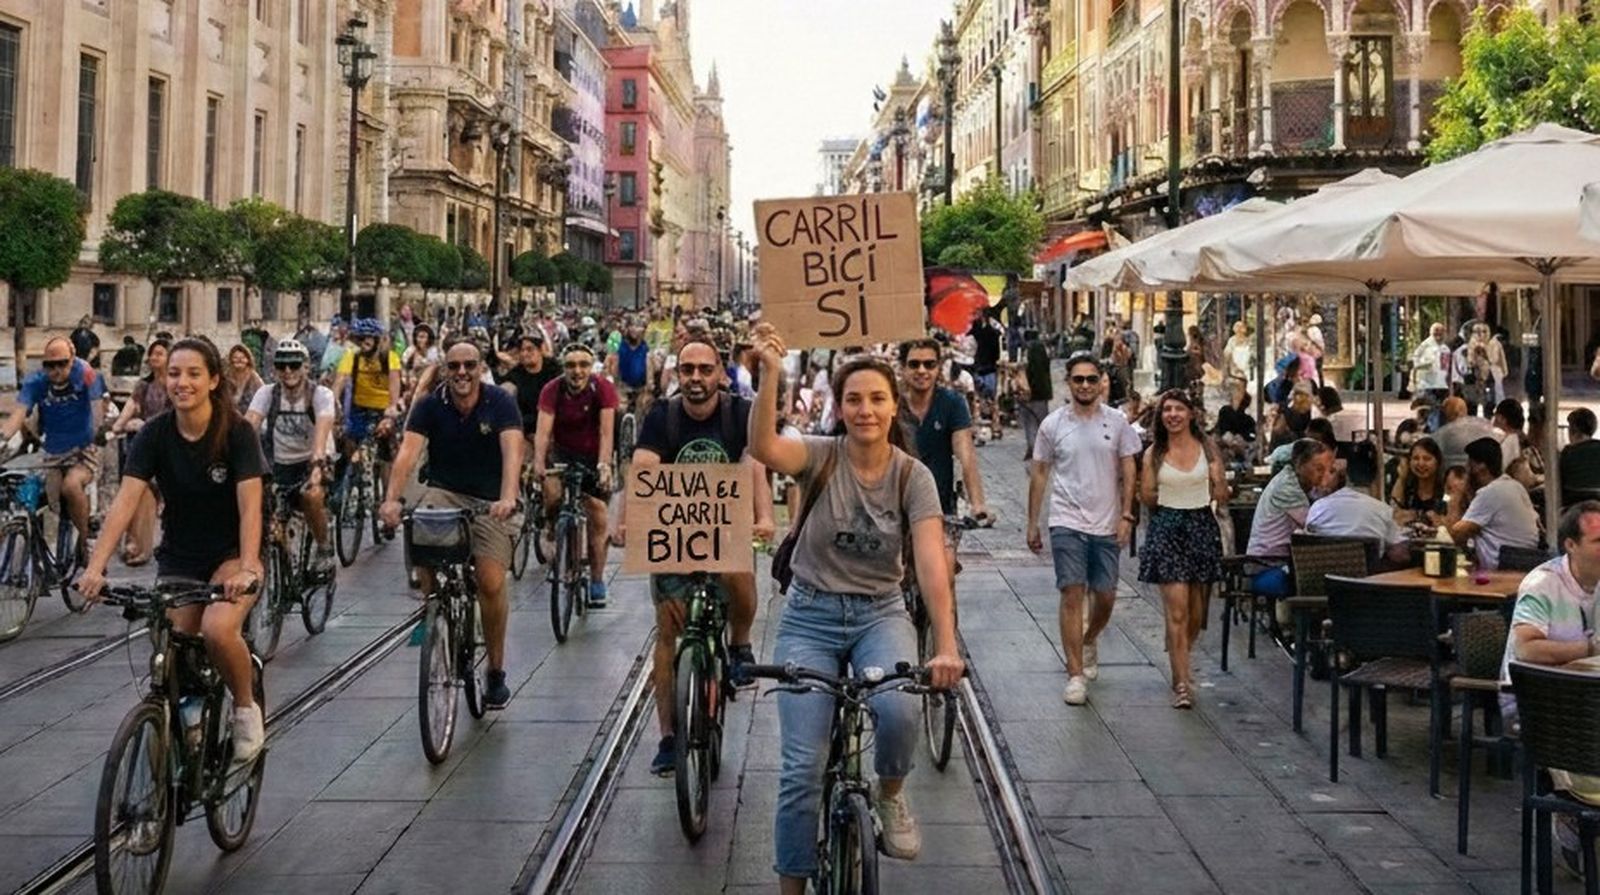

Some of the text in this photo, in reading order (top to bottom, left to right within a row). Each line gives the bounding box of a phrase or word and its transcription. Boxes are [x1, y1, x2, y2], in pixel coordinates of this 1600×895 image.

[765, 198, 898, 248] CARRIL
[635, 470, 710, 498] SALVA
[658, 501, 732, 526] CARRIL
[647, 527, 720, 562] BICI
